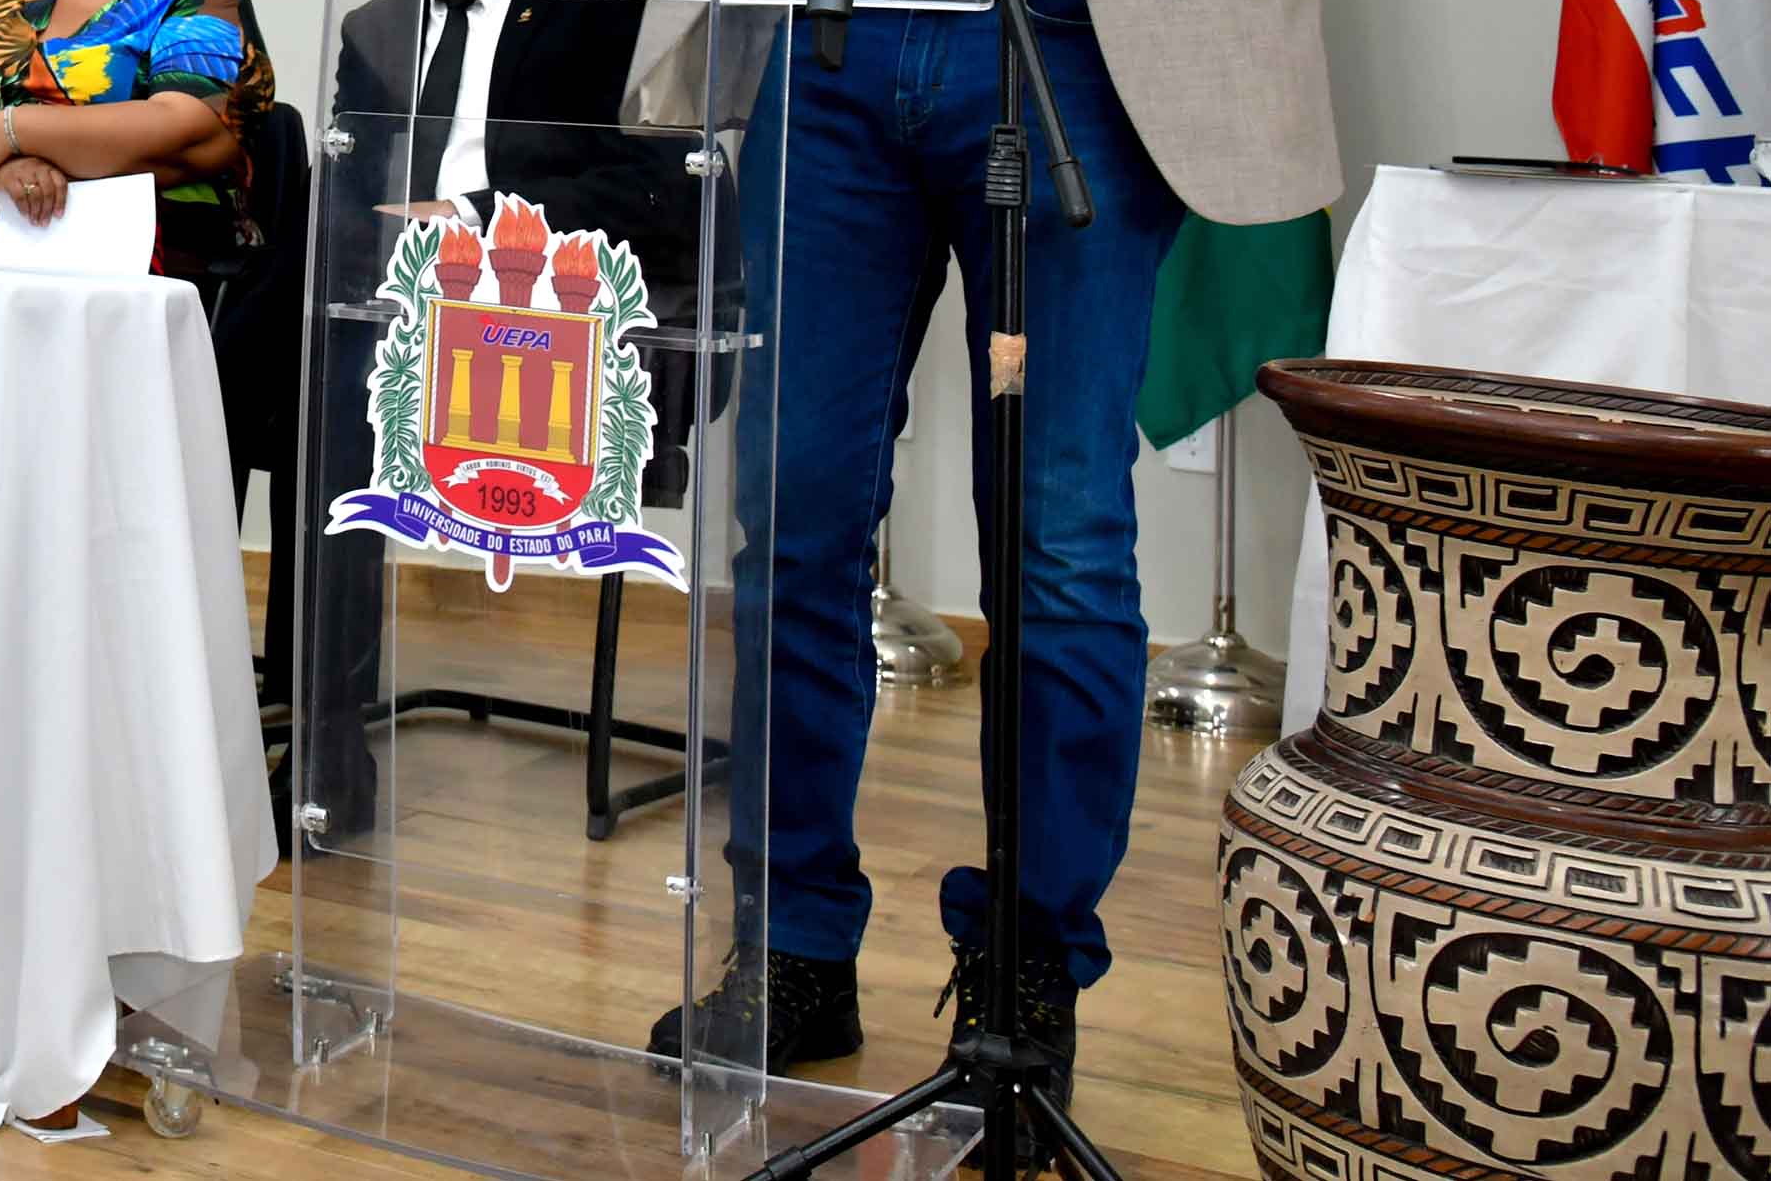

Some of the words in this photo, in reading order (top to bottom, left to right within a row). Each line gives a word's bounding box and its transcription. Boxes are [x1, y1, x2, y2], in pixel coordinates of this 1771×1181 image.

[482, 323, 552, 351] UEPA
[478, 482, 536, 518] 1993
[403, 497, 482, 547] UNIVERSIDADE
[487, 534, 503, 550] DO
[509, 537, 552, 555] ESTADO
[557, 534, 574, 552] DO
[579, 525, 611, 546] PARÁ
